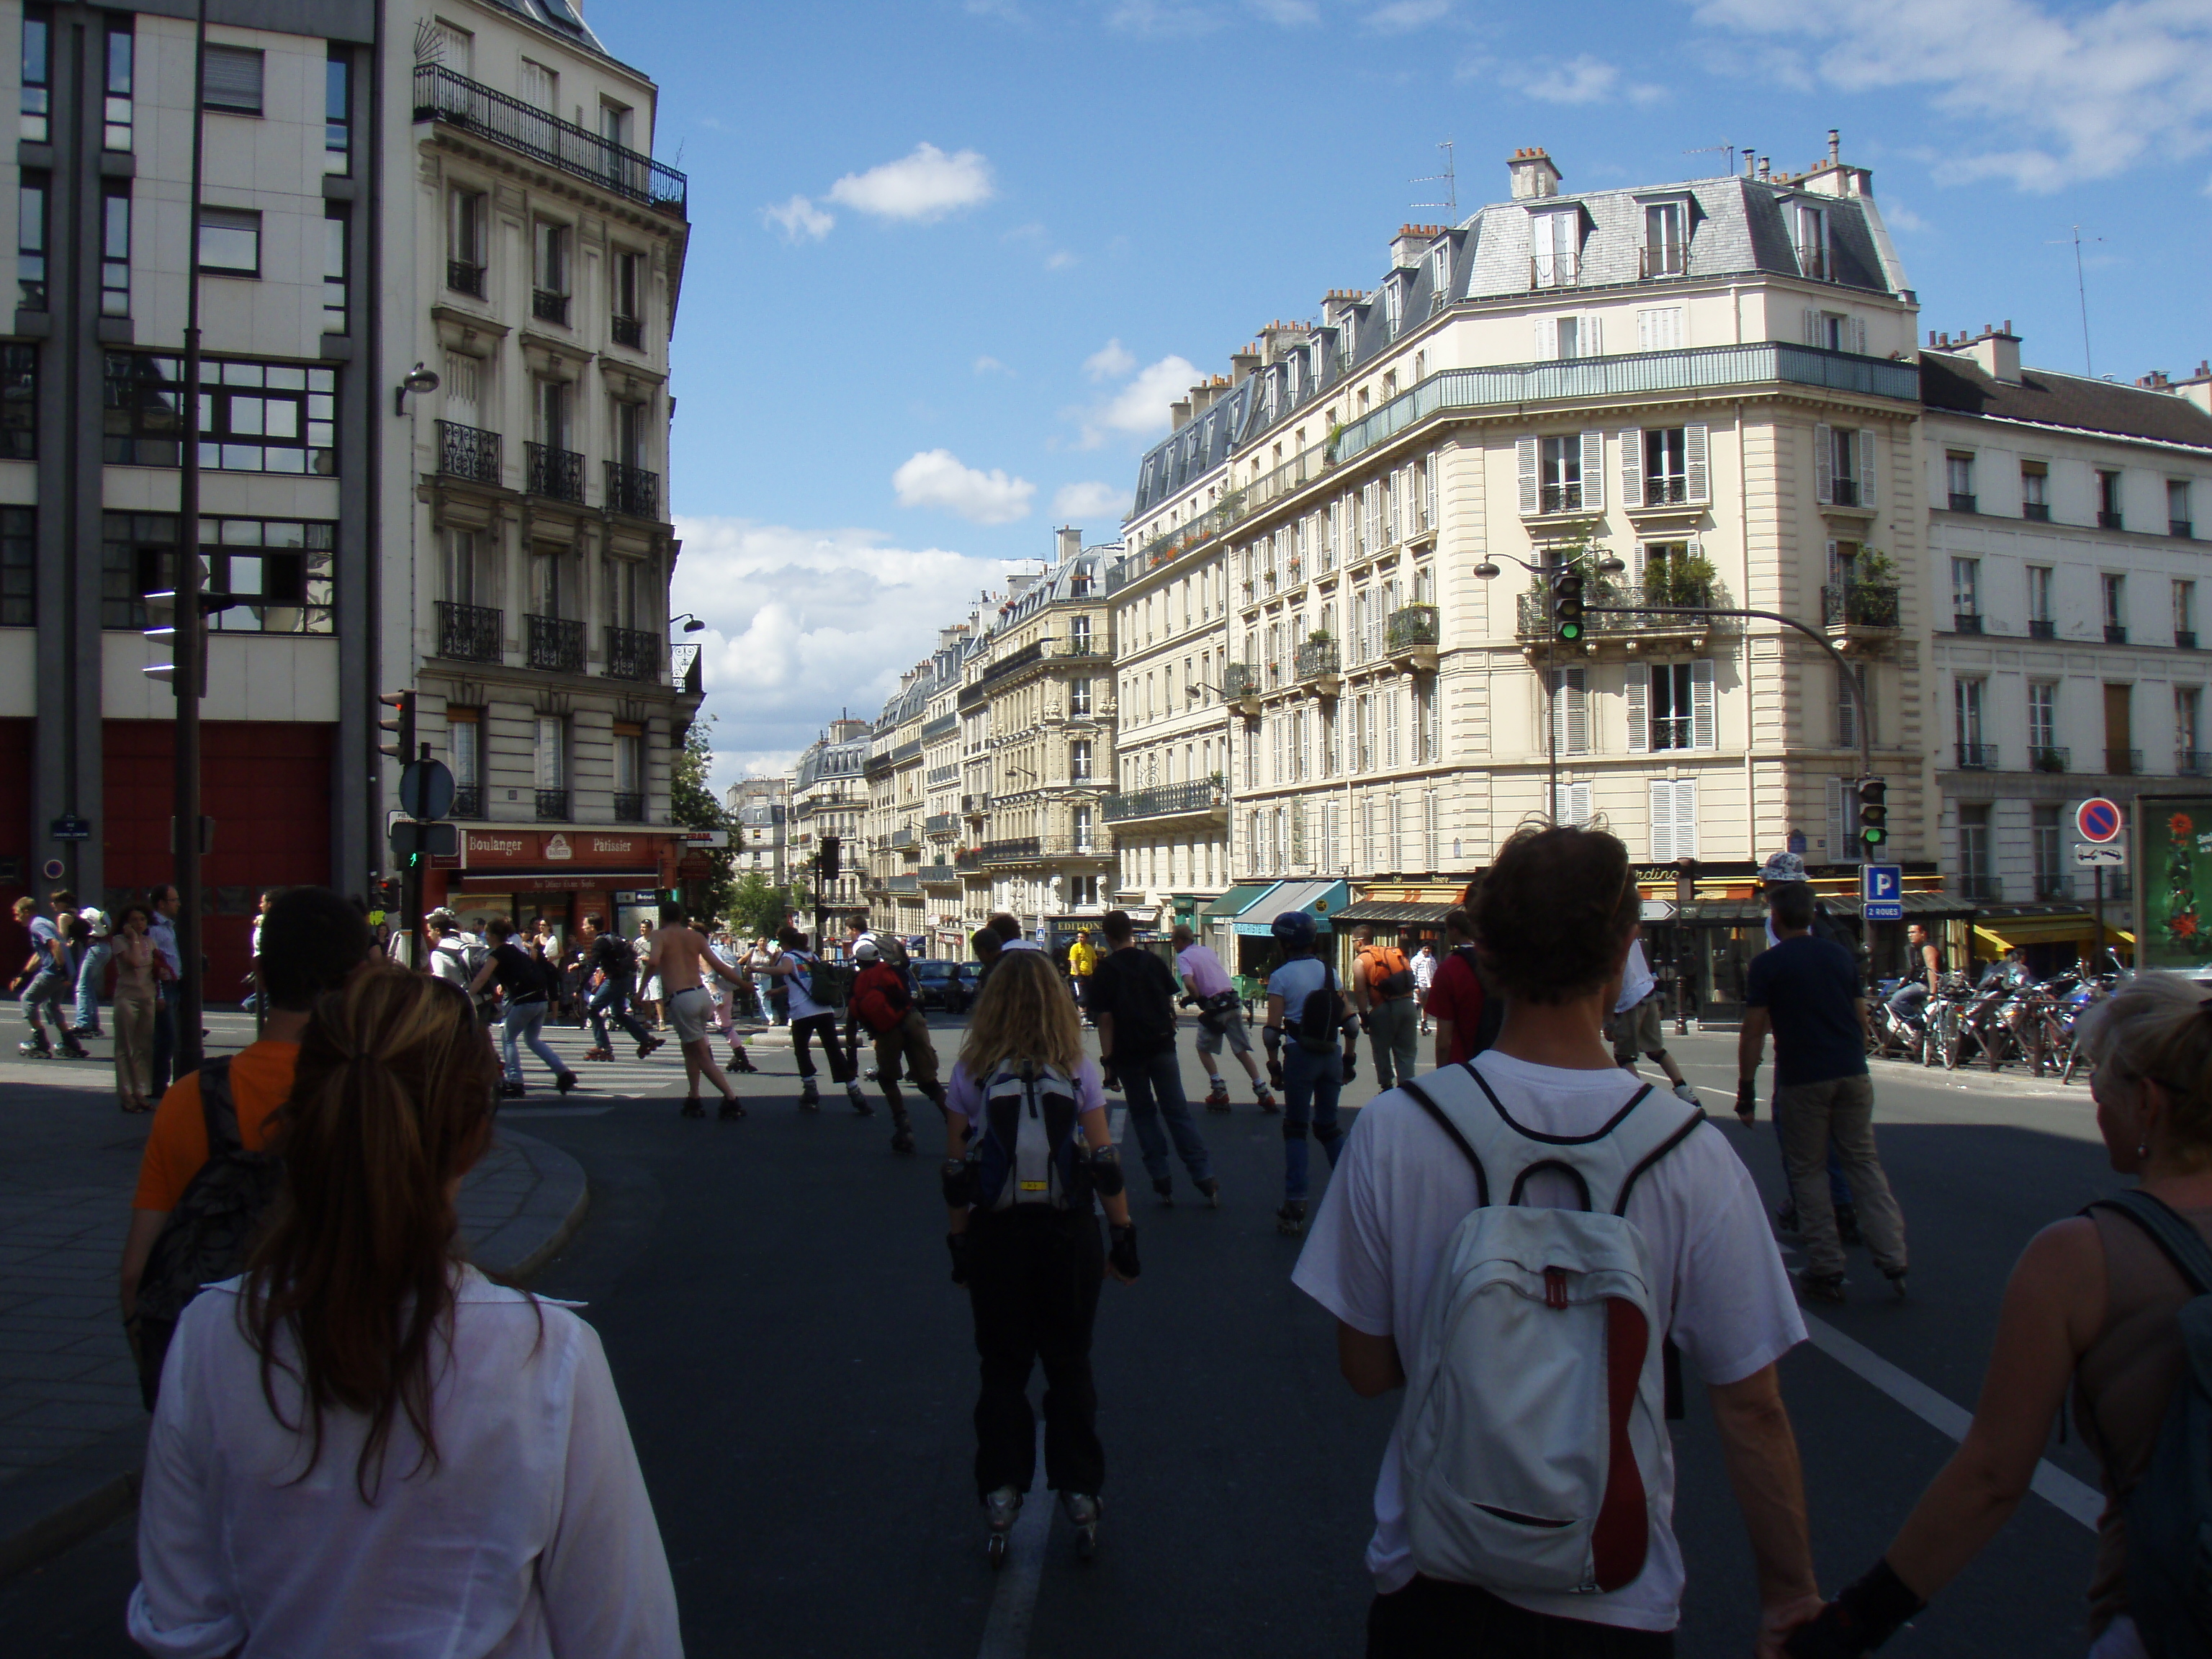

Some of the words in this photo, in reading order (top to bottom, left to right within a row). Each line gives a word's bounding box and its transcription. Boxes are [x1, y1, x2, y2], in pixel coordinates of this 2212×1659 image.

[1293, 799, 1302, 866] FLEURS
[469, 836, 523, 856] Boulanger
[593, 838, 631, 852] Pâtissier
[1876, 873, 1892, 896] P
[1235, 924, 1262, 934] FLEURISTE
